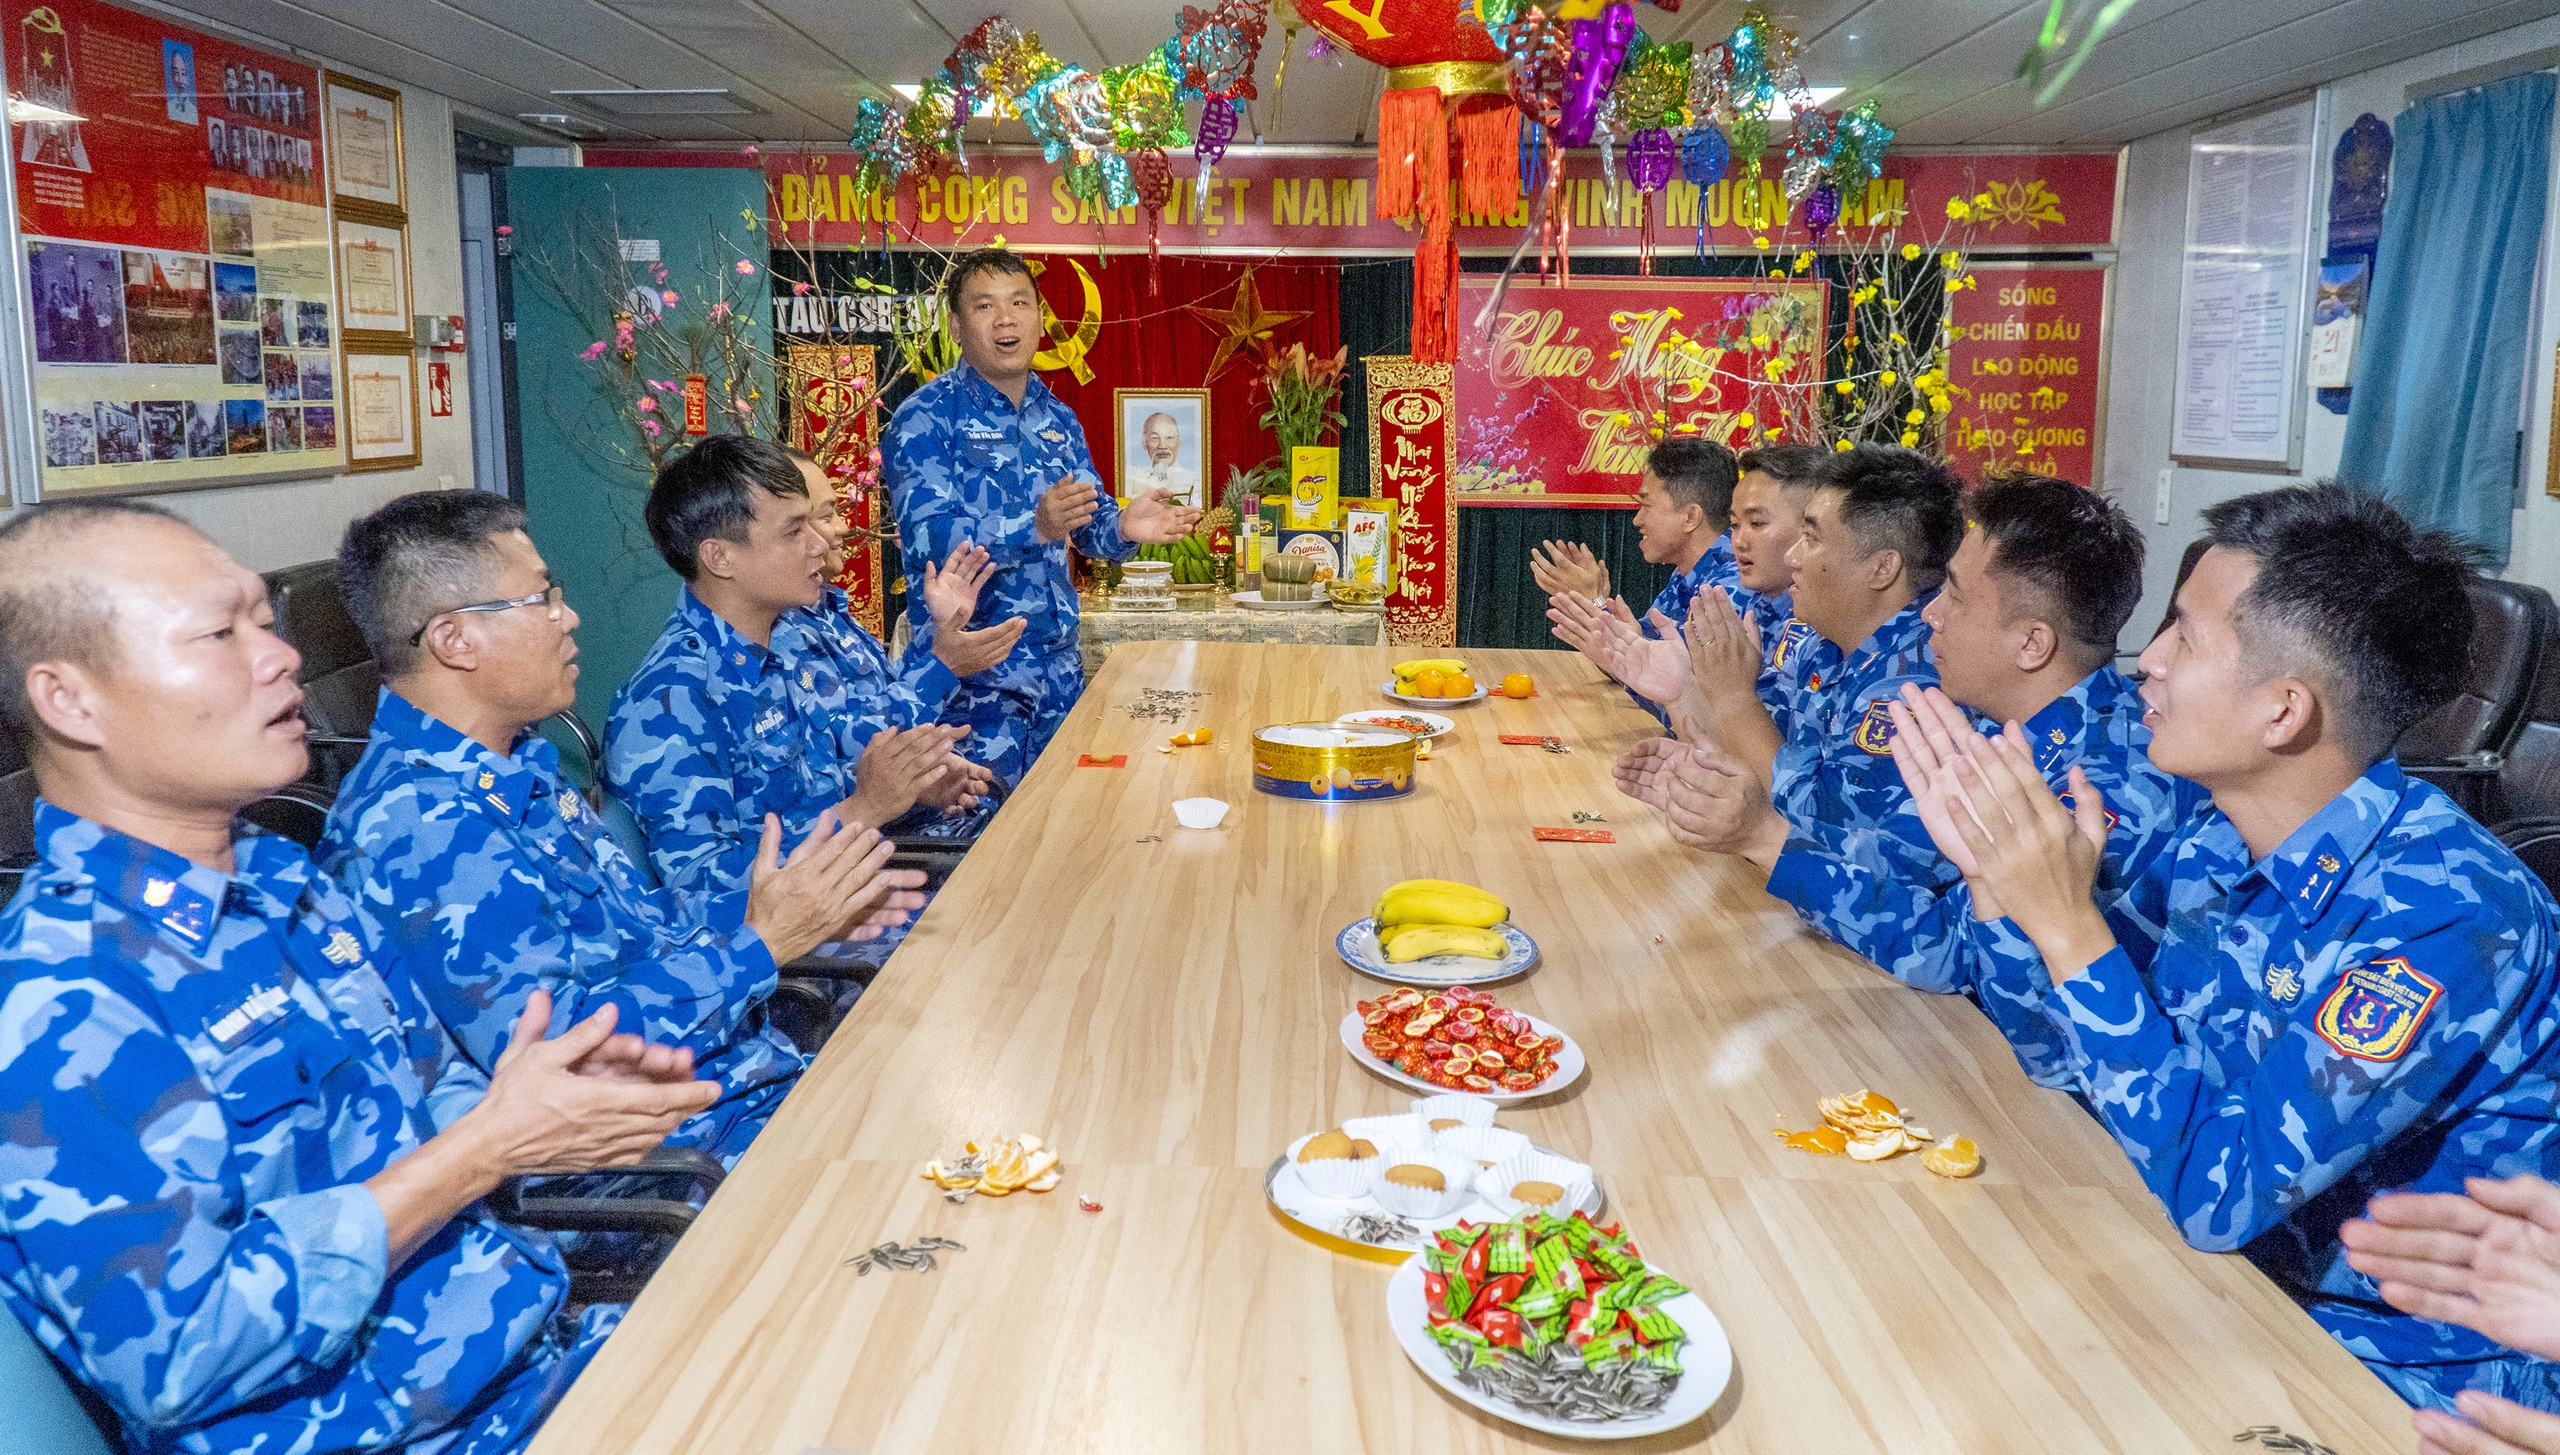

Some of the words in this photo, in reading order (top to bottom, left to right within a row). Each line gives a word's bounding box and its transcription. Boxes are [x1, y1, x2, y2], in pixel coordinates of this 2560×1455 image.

[918, 164, 1029, 234] CỘNG
[1272, 178, 1368, 227] NAM
[838, 295, 895, 334] CSB
[1969, 314, 2030, 341] CHIẾN
[1482, 307, 1595, 388] Chúc
[1397, 398, 1427, 424] 福
[1979, 392, 2022, 414] HỌC
[1394, 435, 1432, 465] Mai
[1353, 520, 1376, 534] AFC
[1291, 543, 1327, 556] Danisa
